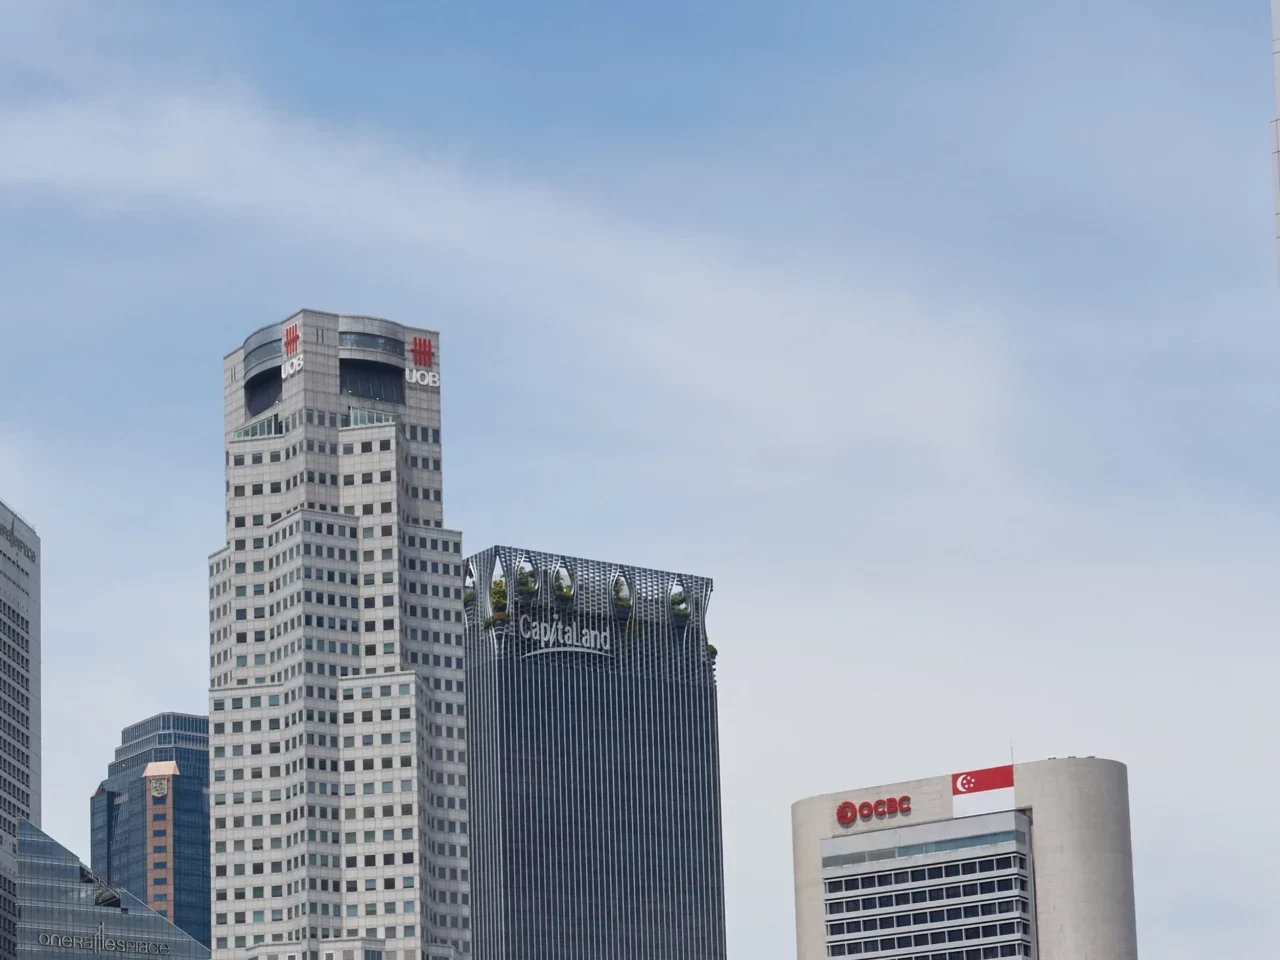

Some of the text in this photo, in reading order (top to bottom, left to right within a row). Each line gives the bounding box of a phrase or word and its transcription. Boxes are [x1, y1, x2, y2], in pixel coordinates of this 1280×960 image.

[281, 354, 304, 379] UOB
[405, 368, 440, 387] UOB
[520, 613, 610, 650] CapitaLand
[858, 795, 912, 818] OCBC
